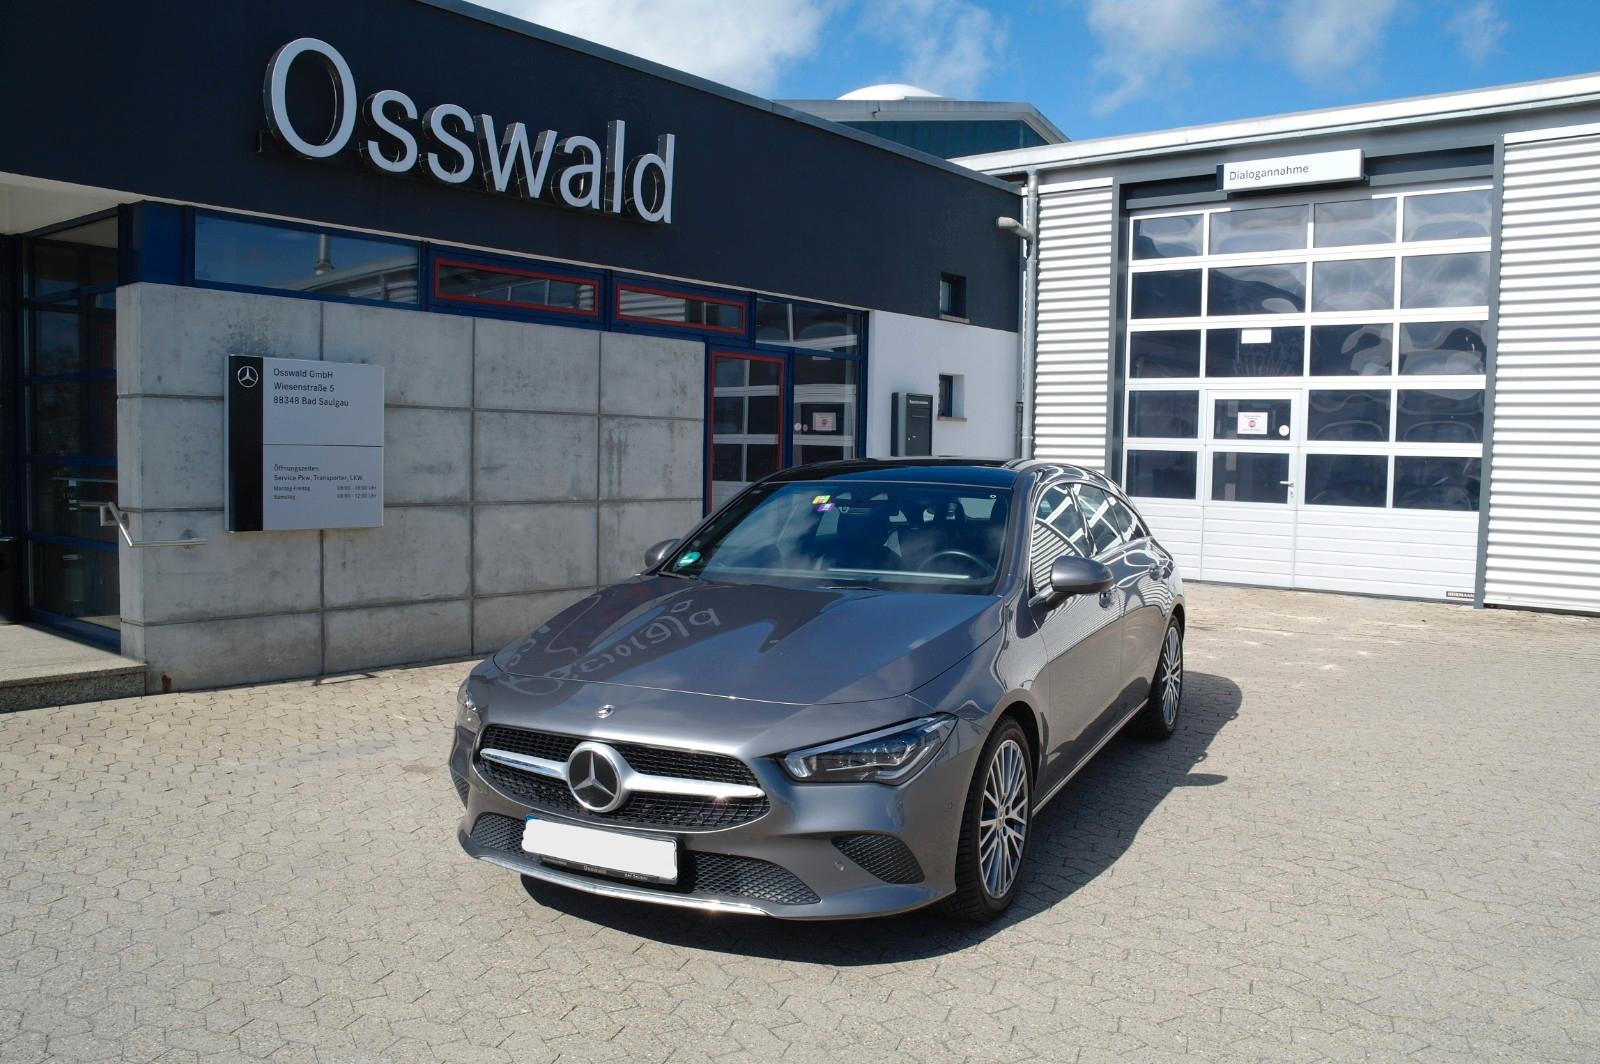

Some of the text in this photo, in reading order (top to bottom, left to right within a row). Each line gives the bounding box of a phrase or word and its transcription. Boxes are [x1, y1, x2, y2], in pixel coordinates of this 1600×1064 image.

[264, 37, 675, 224] Osswald
[1229, 165, 1309, 181] Dialogannahme
[274, 368, 334, 379] Osswald GmbH
[274, 382, 335, 393] Wiesenstraße 5
[274, 396, 349, 408] 88348 Bad Saulgau
[274, 474, 297, 482] Service
